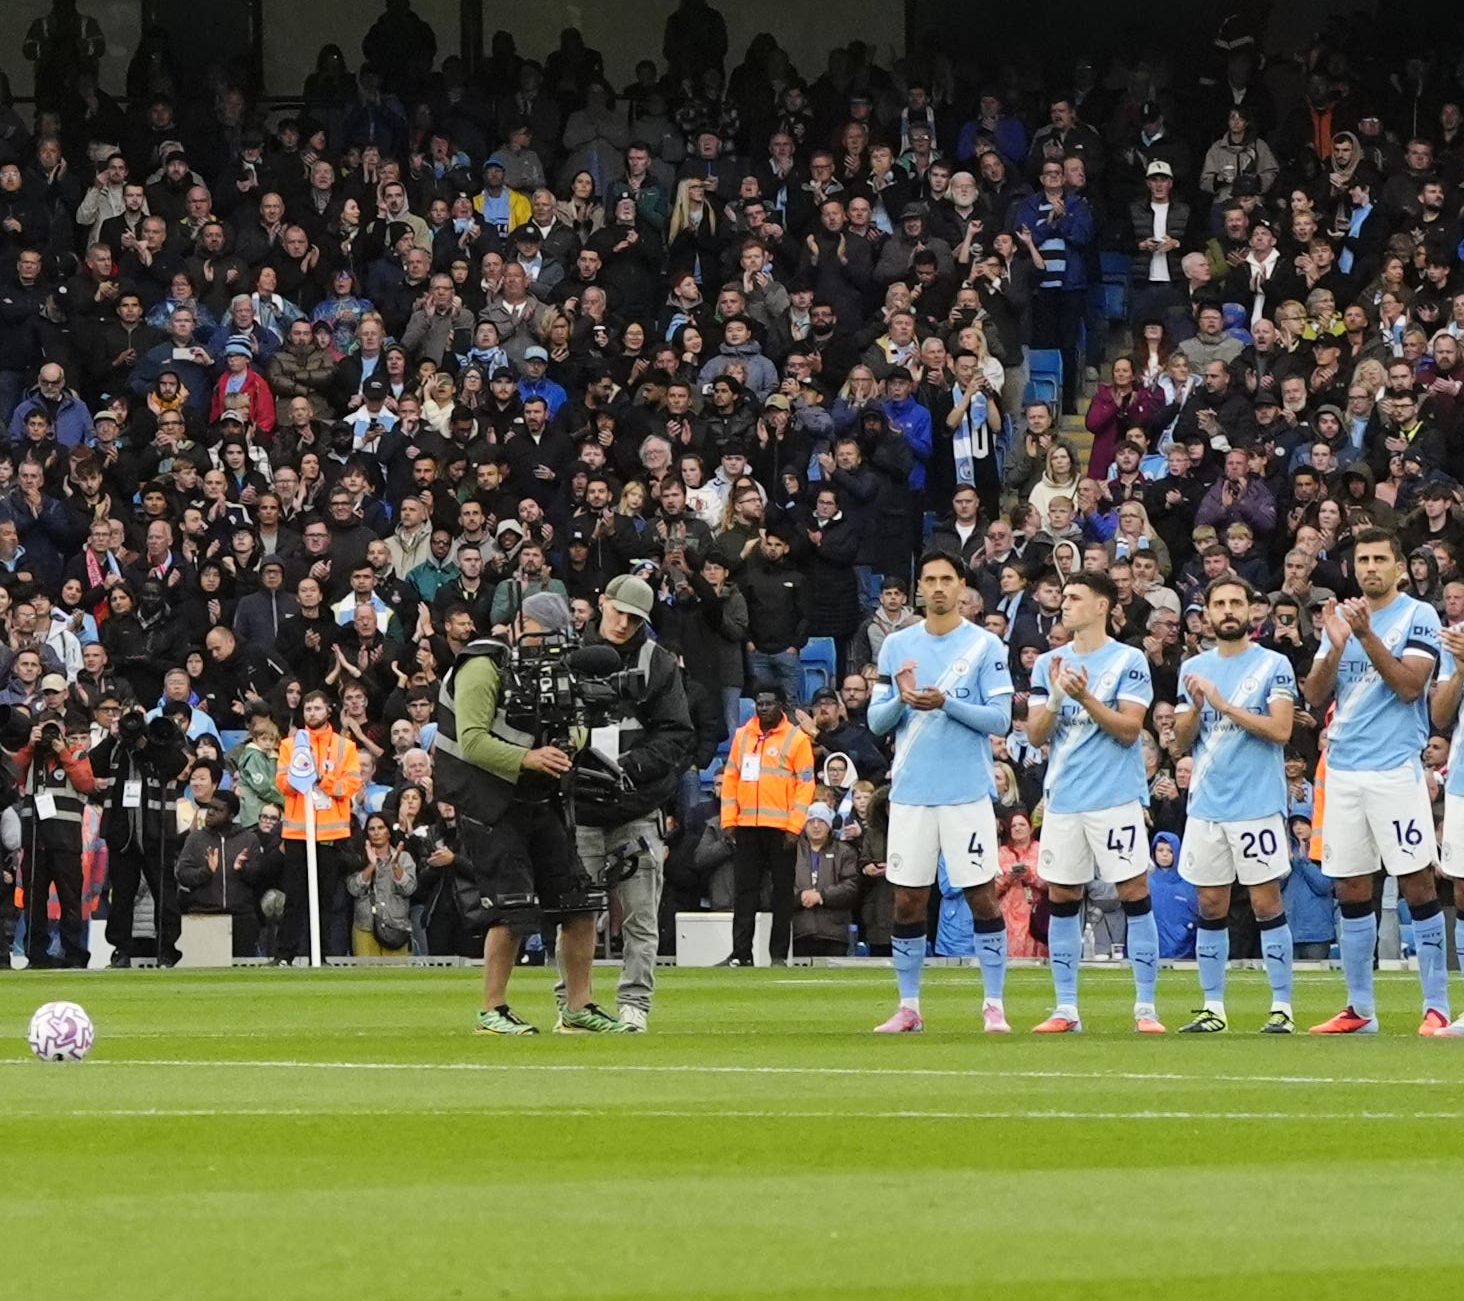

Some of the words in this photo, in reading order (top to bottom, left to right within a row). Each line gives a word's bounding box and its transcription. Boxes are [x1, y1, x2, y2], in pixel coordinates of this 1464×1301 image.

[967, 832, 984, 858] 4
[1106, 825, 1136, 853] 47
[1240, 828, 1277, 859] 20
[1392, 819, 1423, 846] 16
